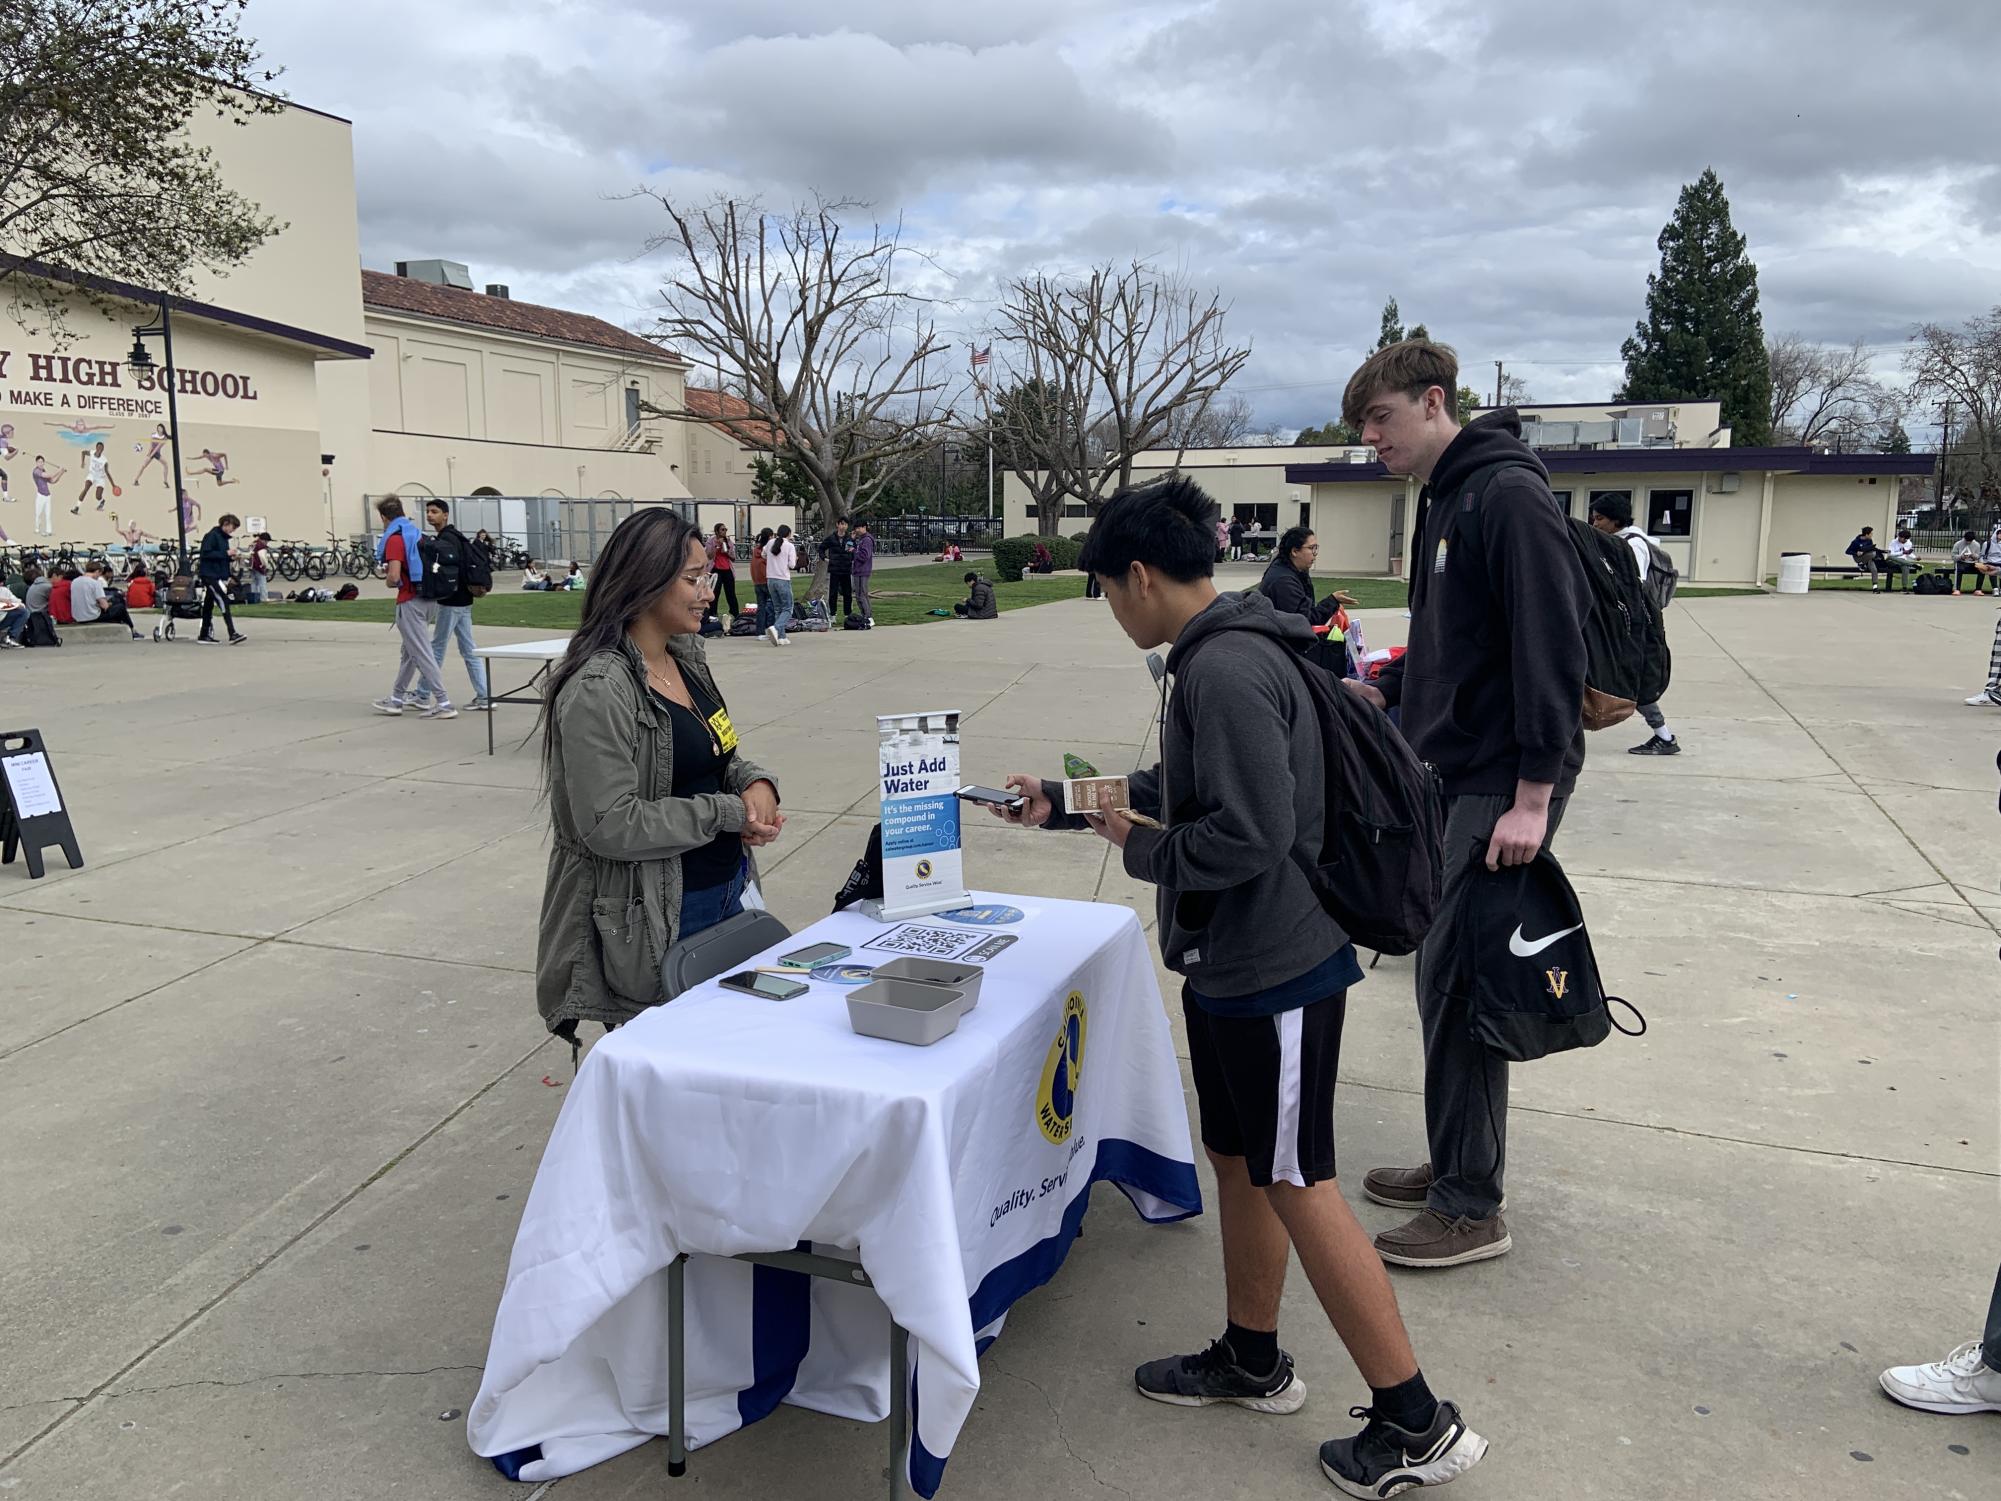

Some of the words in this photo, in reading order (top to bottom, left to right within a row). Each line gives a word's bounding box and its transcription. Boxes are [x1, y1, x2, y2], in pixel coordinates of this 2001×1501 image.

[28, 353, 122, 388] HIGH
[137, 364, 258, 400] SCHOOL
[9, 389, 54, 407] MAKE
[60, 393, 71, 408] A
[77, 394, 163, 414] DIFFERENCE
[883, 760, 914, 778] Just
[918, 756, 946, 774] Add
[883, 778, 930, 794] Water
[884, 804, 898, 815] It's
[899, 803, 913, 813] the
[914, 801, 944, 811] missing
[884, 812, 926, 825] compound
[927, 811, 936, 820] in
[885, 827, 904, 837] your
[905, 824, 932, 834] career.
[990, 1188, 1036, 1228] Quality.
